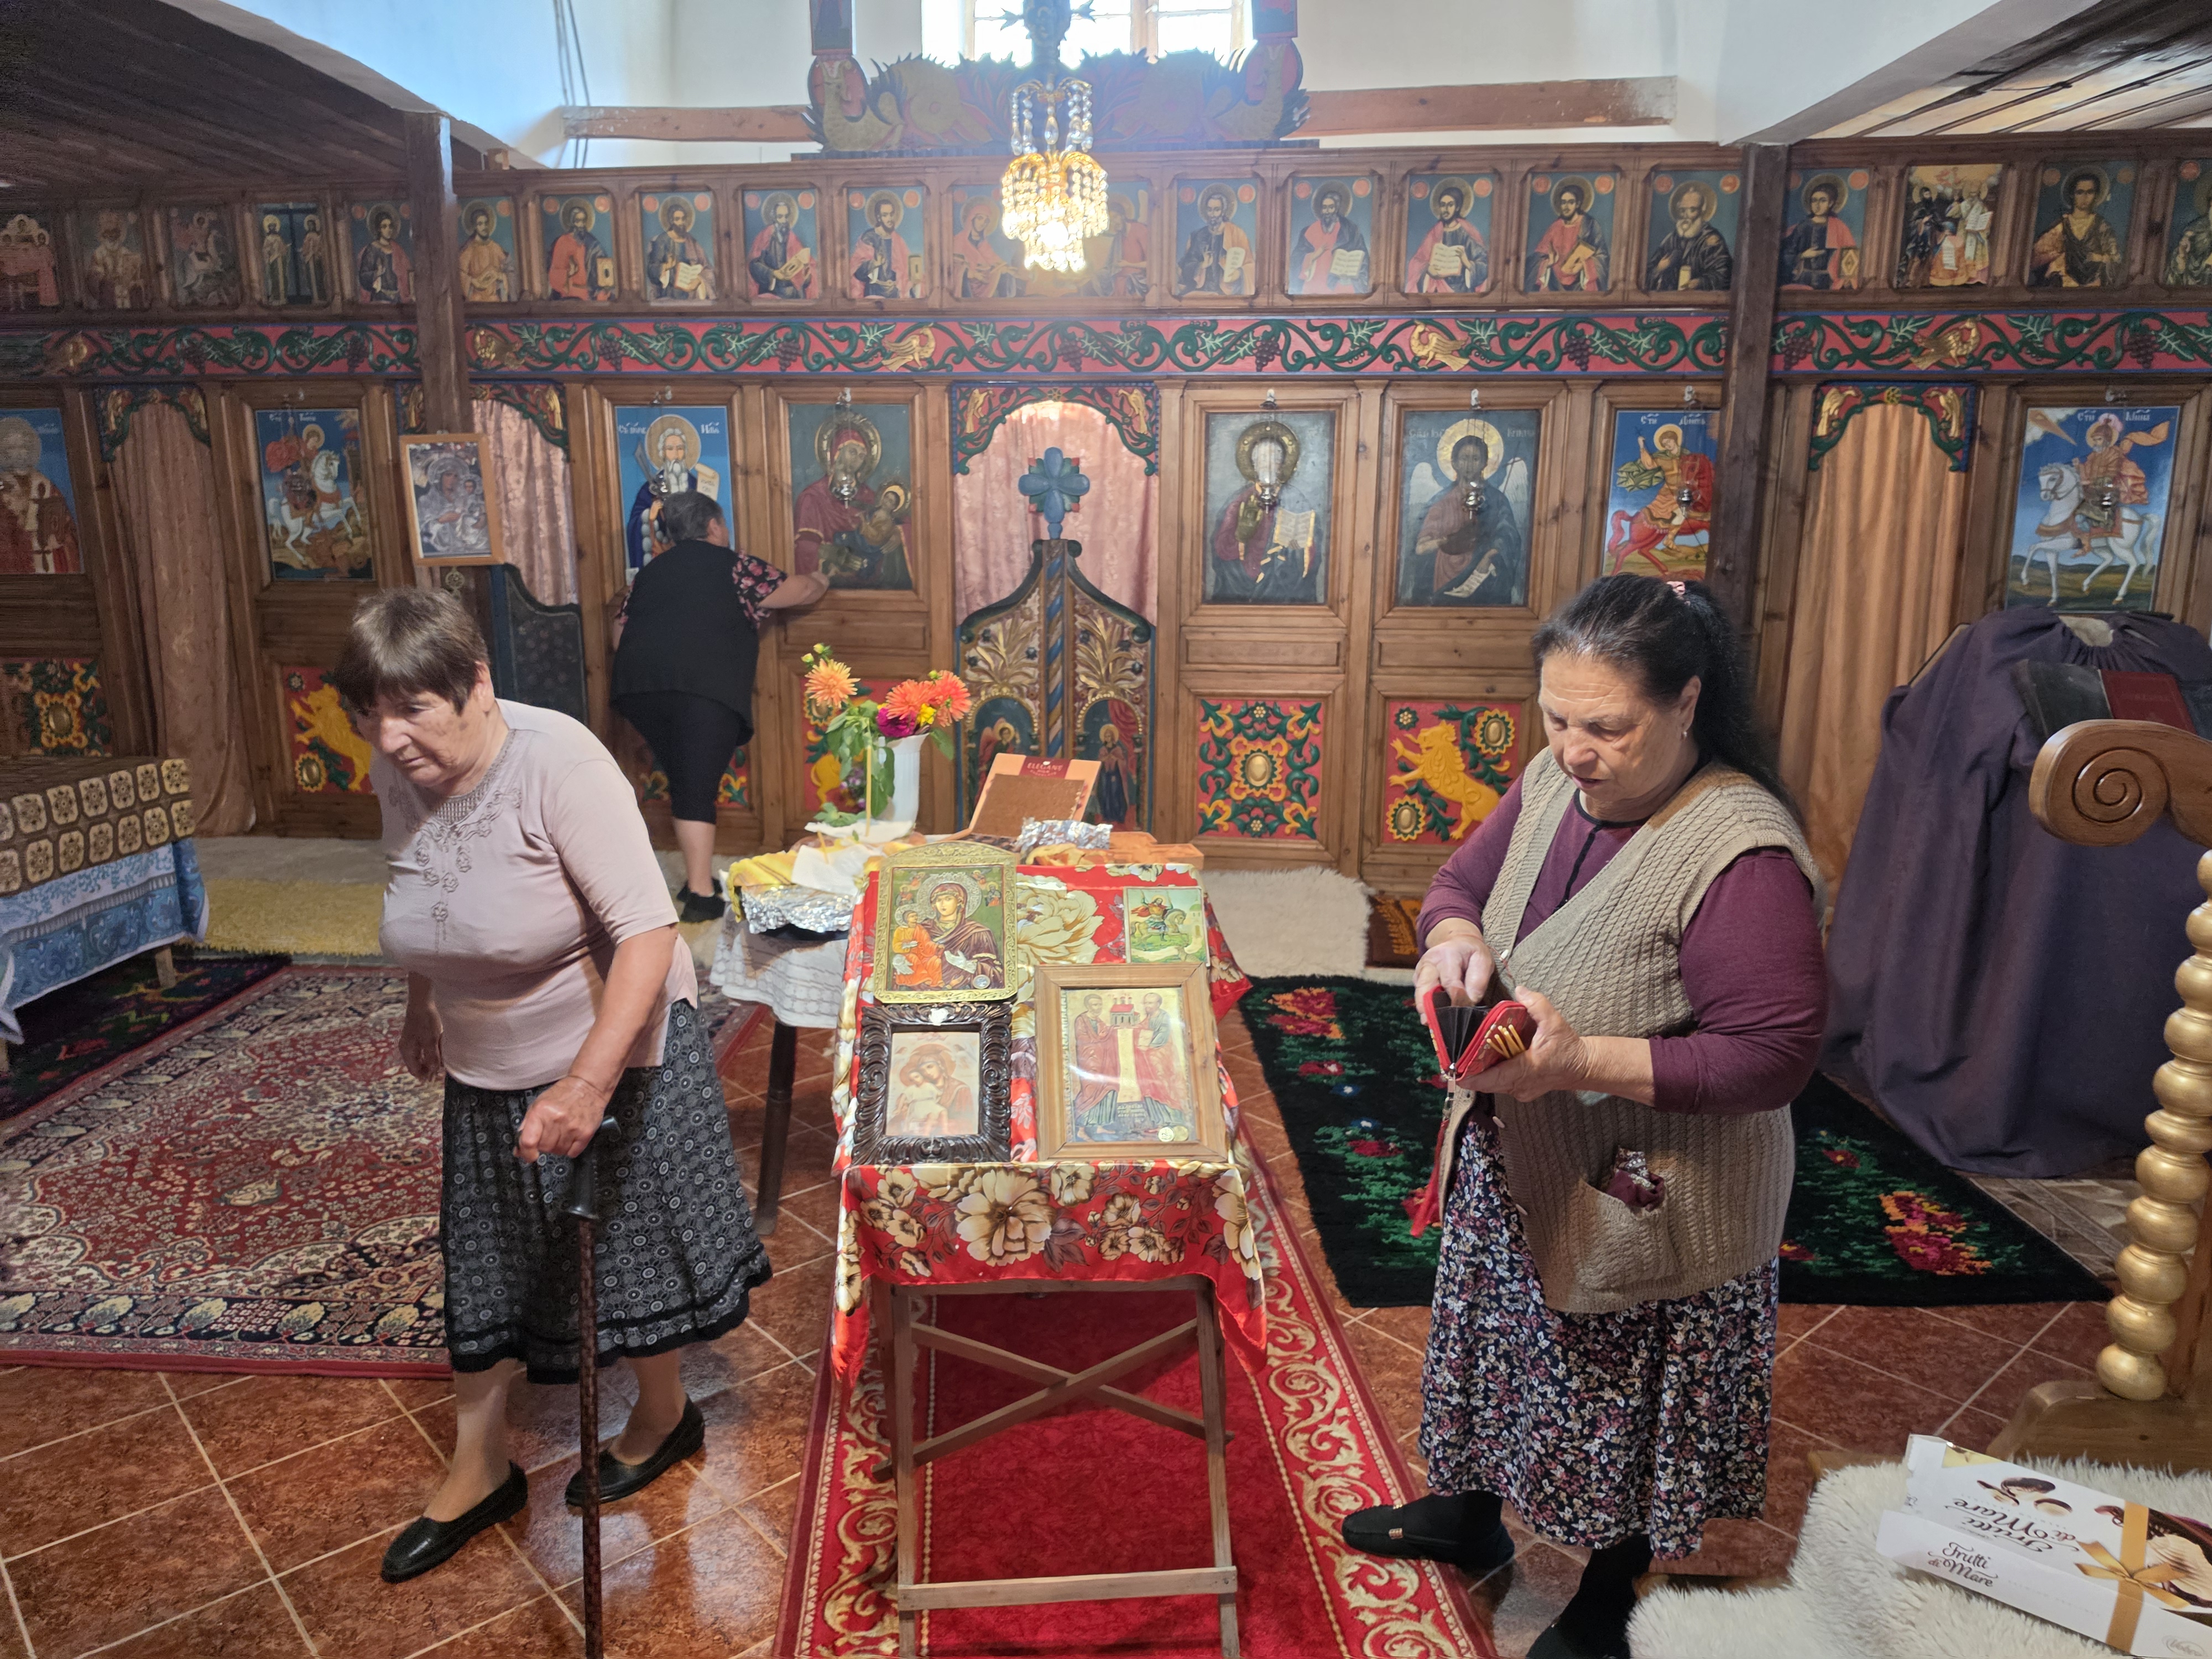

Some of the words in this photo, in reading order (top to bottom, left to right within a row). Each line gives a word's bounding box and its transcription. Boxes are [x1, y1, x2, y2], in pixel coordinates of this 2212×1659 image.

[1945, 1498, 2048, 1540] Mare
[1962, 1517, 2053, 1552] Frutti
[2051, 1530, 2076, 1541] di
[1942, 1542, 1991, 1569] Frutti
[1928, 1558, 1940, 1568] di
[1942, 1556, 1998, 1587] Mare
